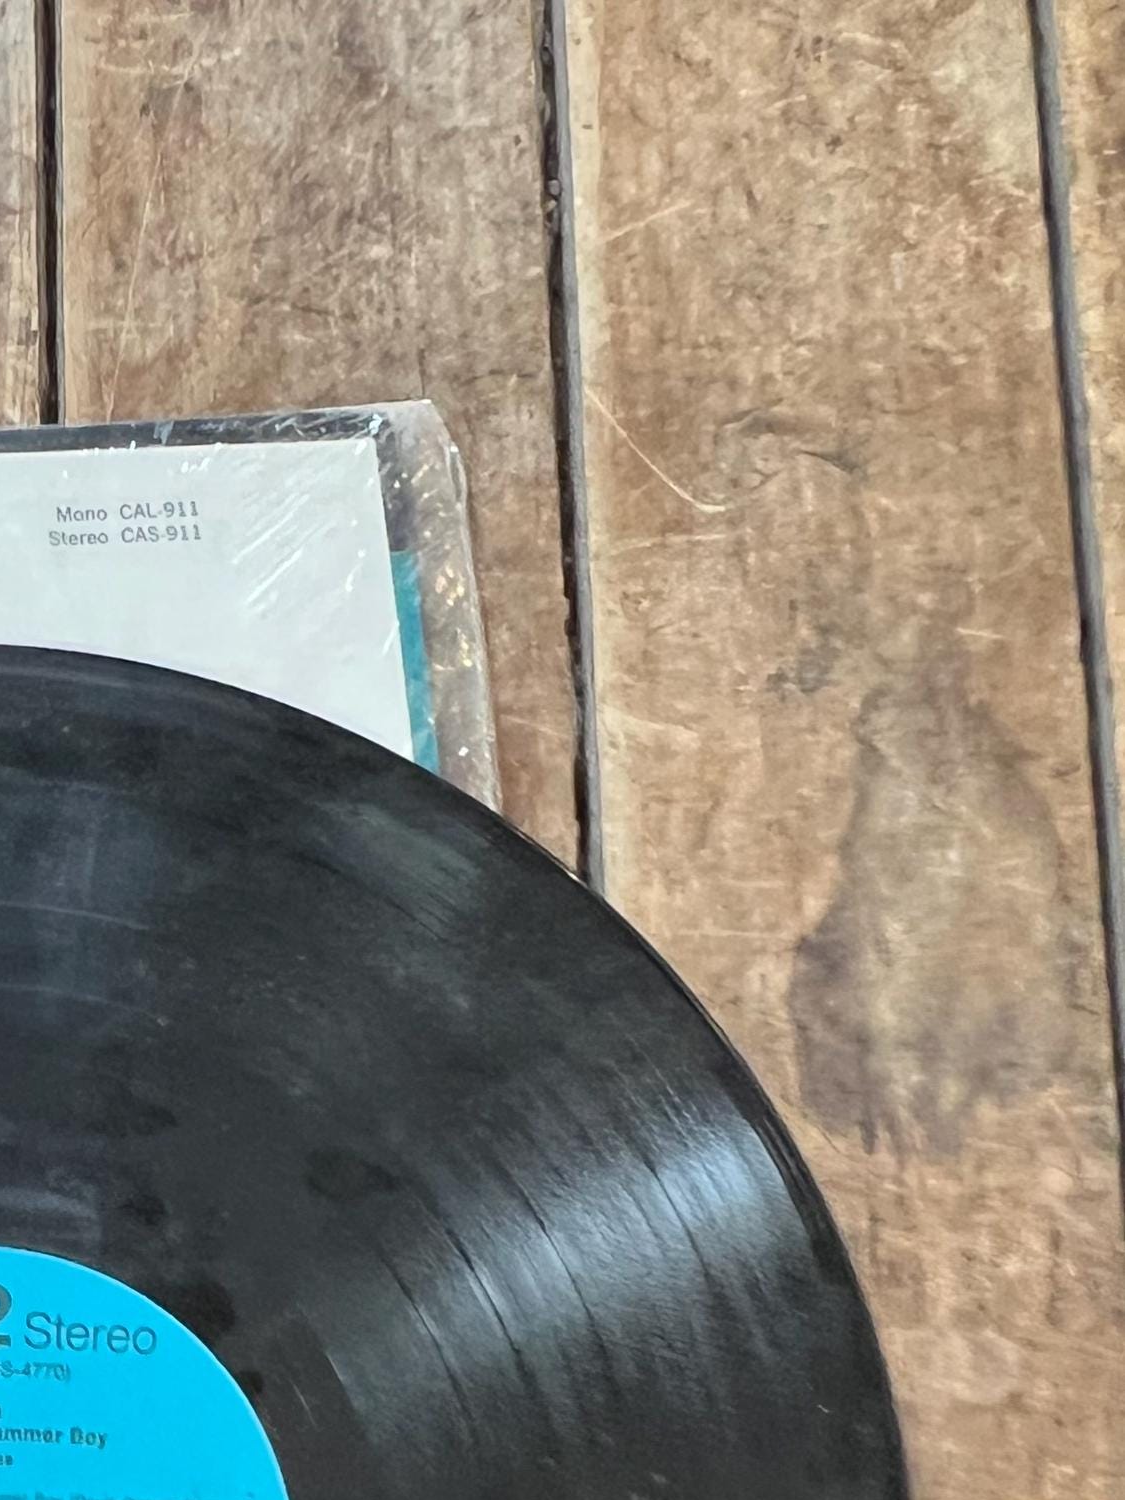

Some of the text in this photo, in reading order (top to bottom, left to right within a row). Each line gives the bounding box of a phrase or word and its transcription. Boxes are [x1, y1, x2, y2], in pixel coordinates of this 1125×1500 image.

[56, 501, 199, 523] Mono CAL-911
[48, 524, 202, 546] Stereo CAS-911
[24, 1310, 157, 1355] Stereo
[69, 1427, 108, 1450] Boy
